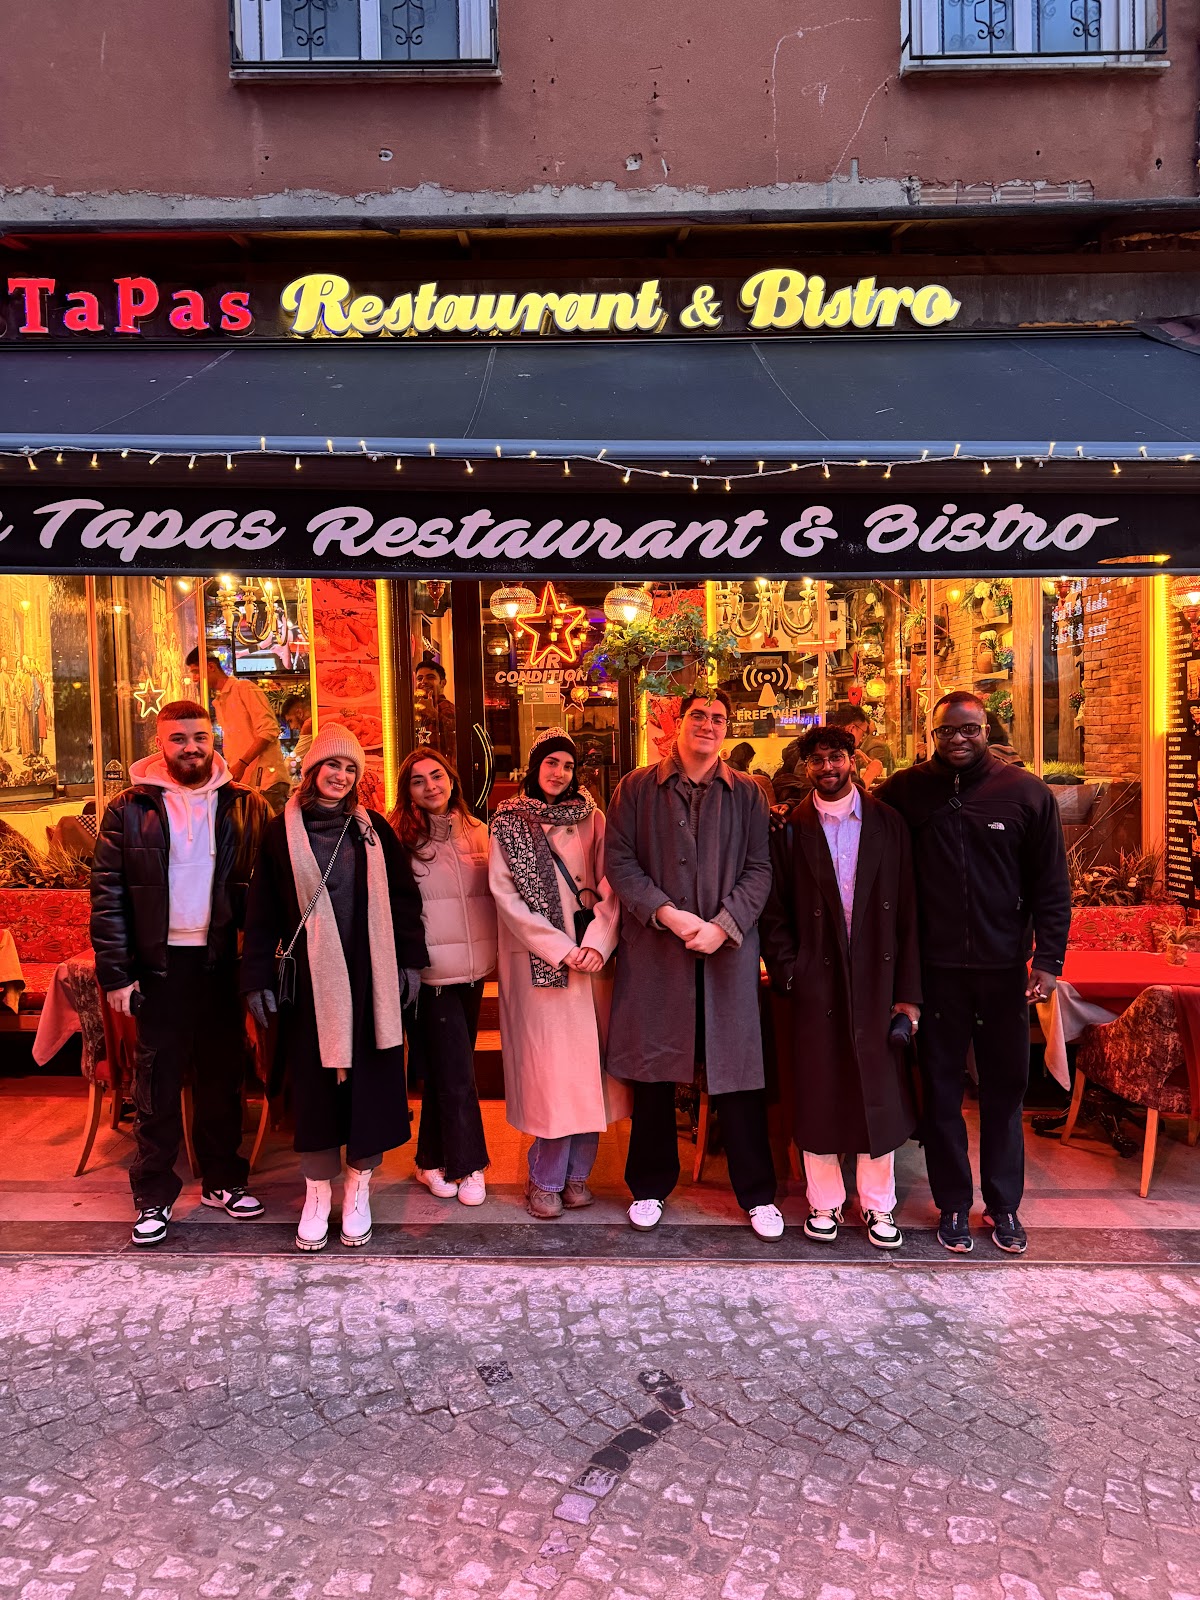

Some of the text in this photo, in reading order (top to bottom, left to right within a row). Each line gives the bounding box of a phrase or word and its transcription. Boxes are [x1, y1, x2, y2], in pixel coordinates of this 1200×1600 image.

[281, 273, 664, 333] Restaurant
[680, 285, 722, 328] &
[741, 268, 962, 329] Bistro
[33, 499, 287, 563] Tapas
[307, 506, 769, 560] Restaurant
[781, 505, 839, 558] &
[863, 503, 1120, 554] Bistro
[523, 653, 562, 669] AIR
[495, 669, 588, 683] CONDITION
[737, 709, 768, 721] FREE
